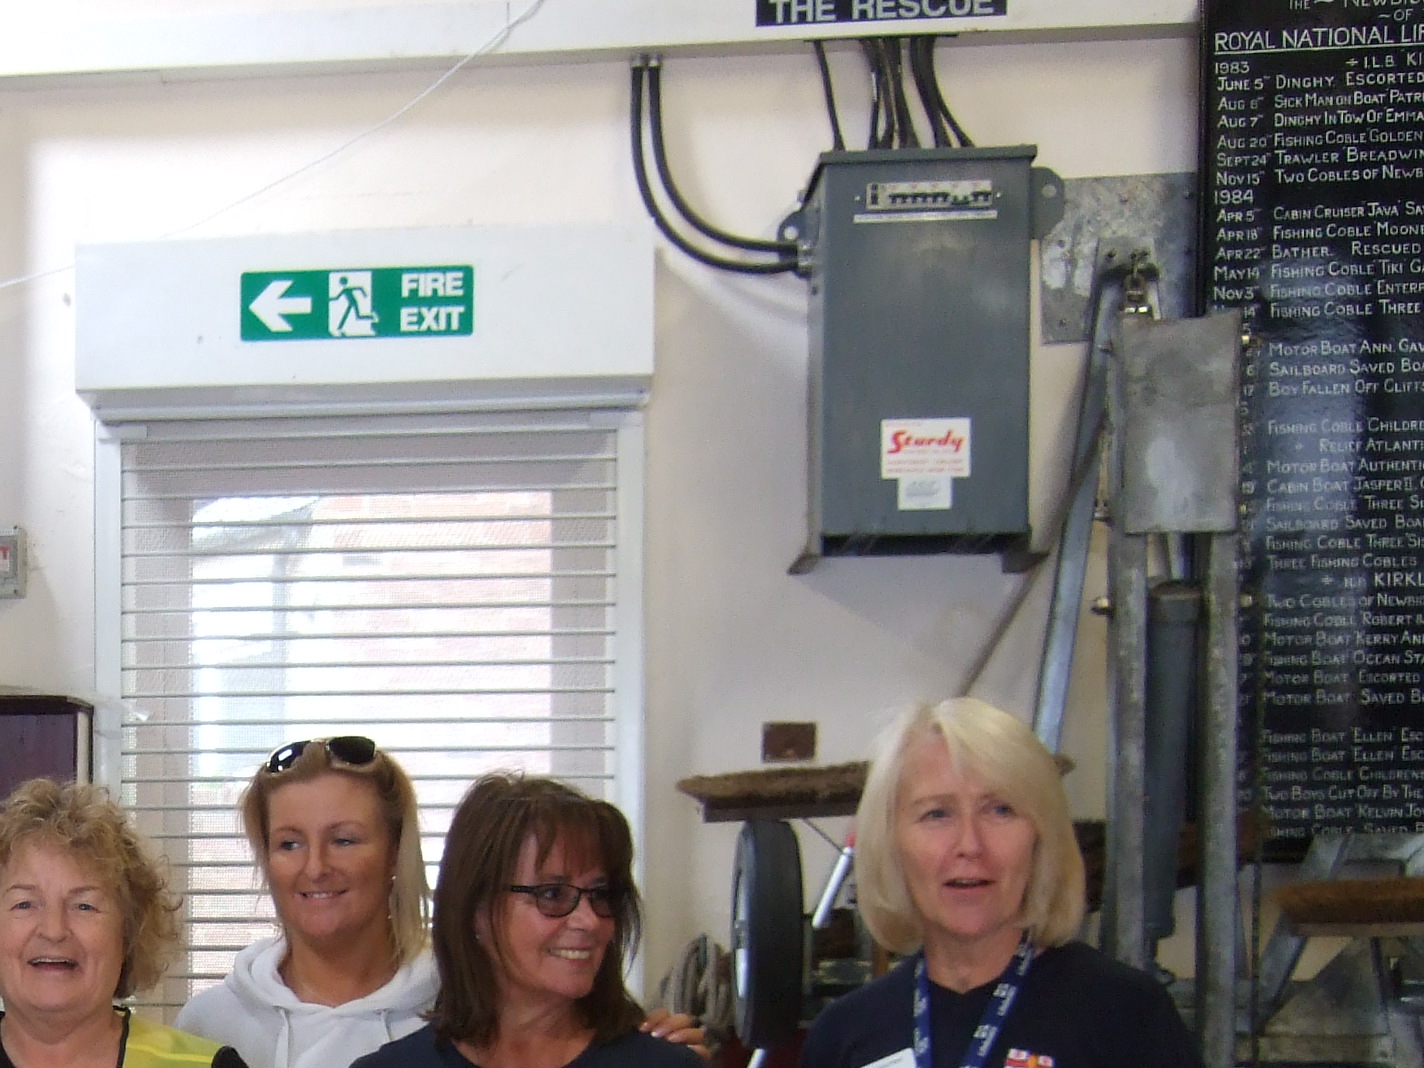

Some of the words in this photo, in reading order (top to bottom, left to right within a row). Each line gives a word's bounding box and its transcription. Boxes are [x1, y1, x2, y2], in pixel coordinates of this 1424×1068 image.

[770, 0, 837, 24] THE
[851, 0, 995, 20] RESCUE
[1215, 31, 1275, 51] ROYAL
[1282, 26, 1394, 48] NATIONAL
[1215, 61, 1250, 75] 1983
[1275, 150, 1339, 165] TRAWLER
[1275, 169, 1305, 184] TWO
[1308, 168, 1360, 182] COBLES
[1215, 189, 1254, 205] 1984
[1273, 225, 1323, 240] FISHING
[1326, 223, 1372, 237] COBLE
[1351, 241, 1421, 256] RESCUED
[401, 272, 464, 298] FIRE
[400, 305, 465, 332] EXIT
[887, 429, 965, 454] Sturdy
